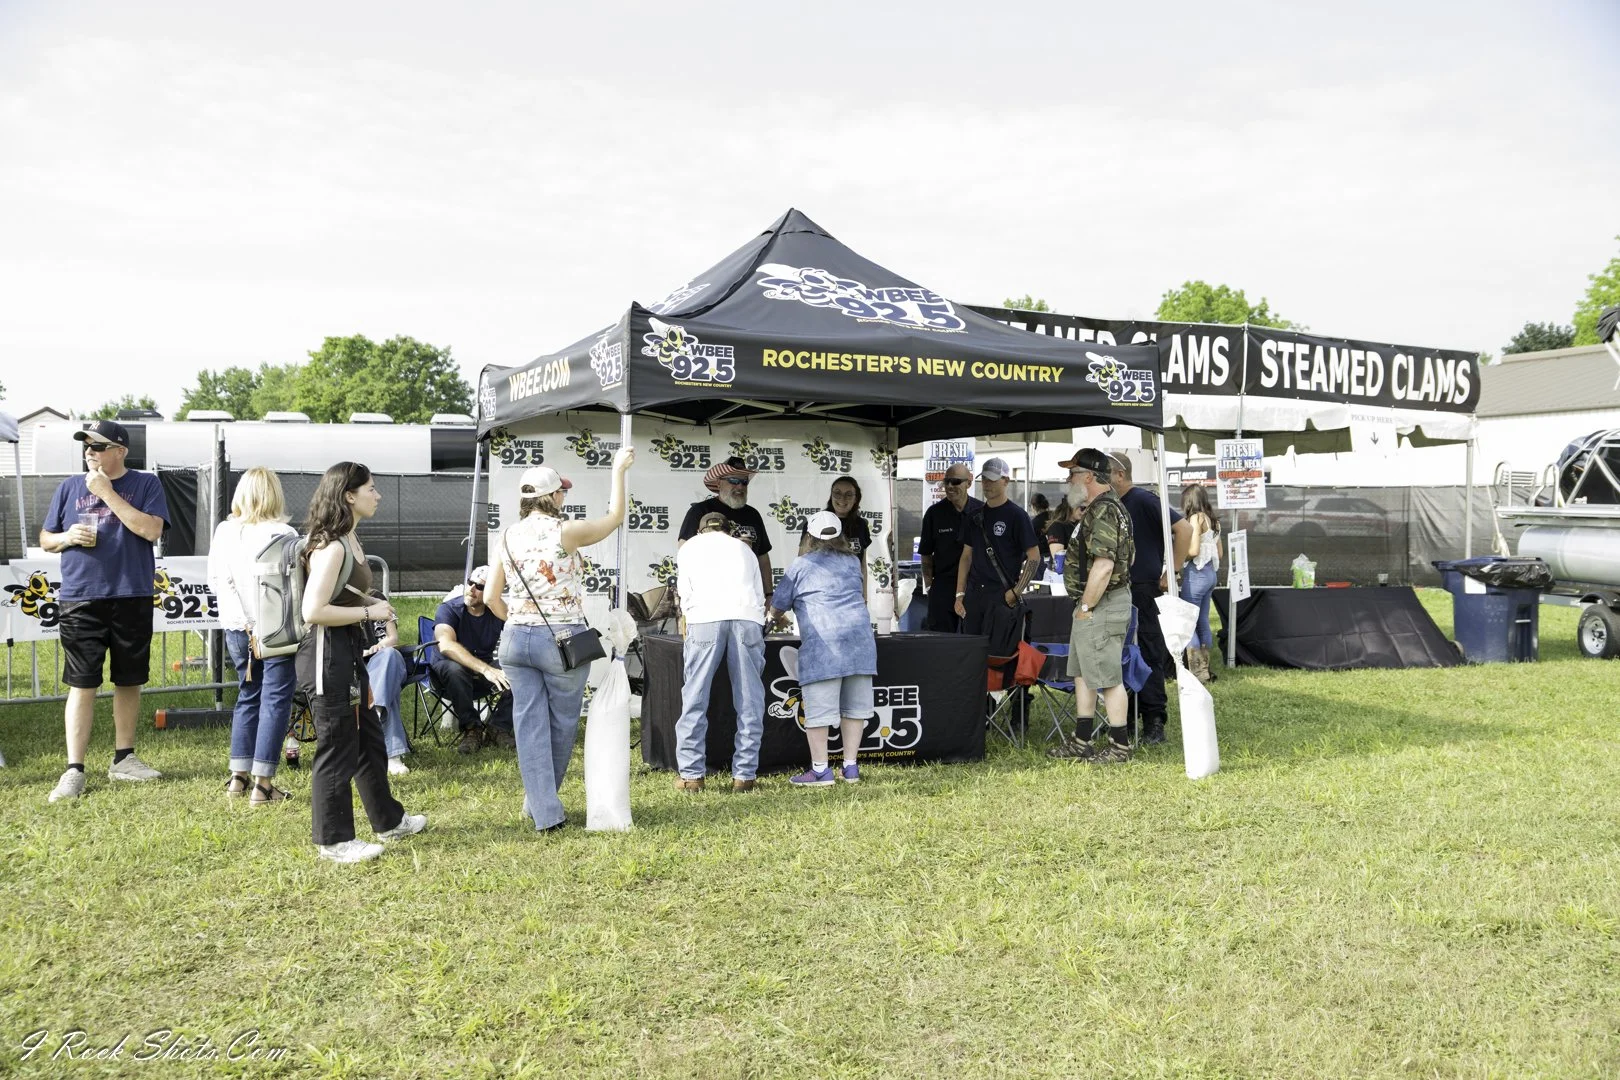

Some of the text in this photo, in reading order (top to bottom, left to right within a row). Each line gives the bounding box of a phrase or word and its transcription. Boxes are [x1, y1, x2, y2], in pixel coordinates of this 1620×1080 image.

[854, 288, 945, 304] WBEE
[690, 344, 733, 358] WBEE
[762, 349, 1065, 384] ROCHESTER'S NEW COUNTRY
[1122, 370, 1152, 381] WBEE
[1261, 339, 1471, 406] STEAMED CLAMS
[508, 355, 571, 403] WBEE.COM
[1351, 414, 1365, 422] PICK
[1376, 416, 1393, 424] HERE
[513, 440, 543, 449] WBEE
[682, 445, 710, 453] WBEE
[931, 442, 968, 458] FRESH
[1222, 443, 1256, 457] FRESH
[756, 447, 783, 455] WBEE
[828, 448, 853, 458] WBEE
[1218, 460, 1242, 470] LITTLE
[639, 506, 669, 514] WBEE
[179, 584, 212, 594] WBE
[873, 687, 917, 707] BEE
